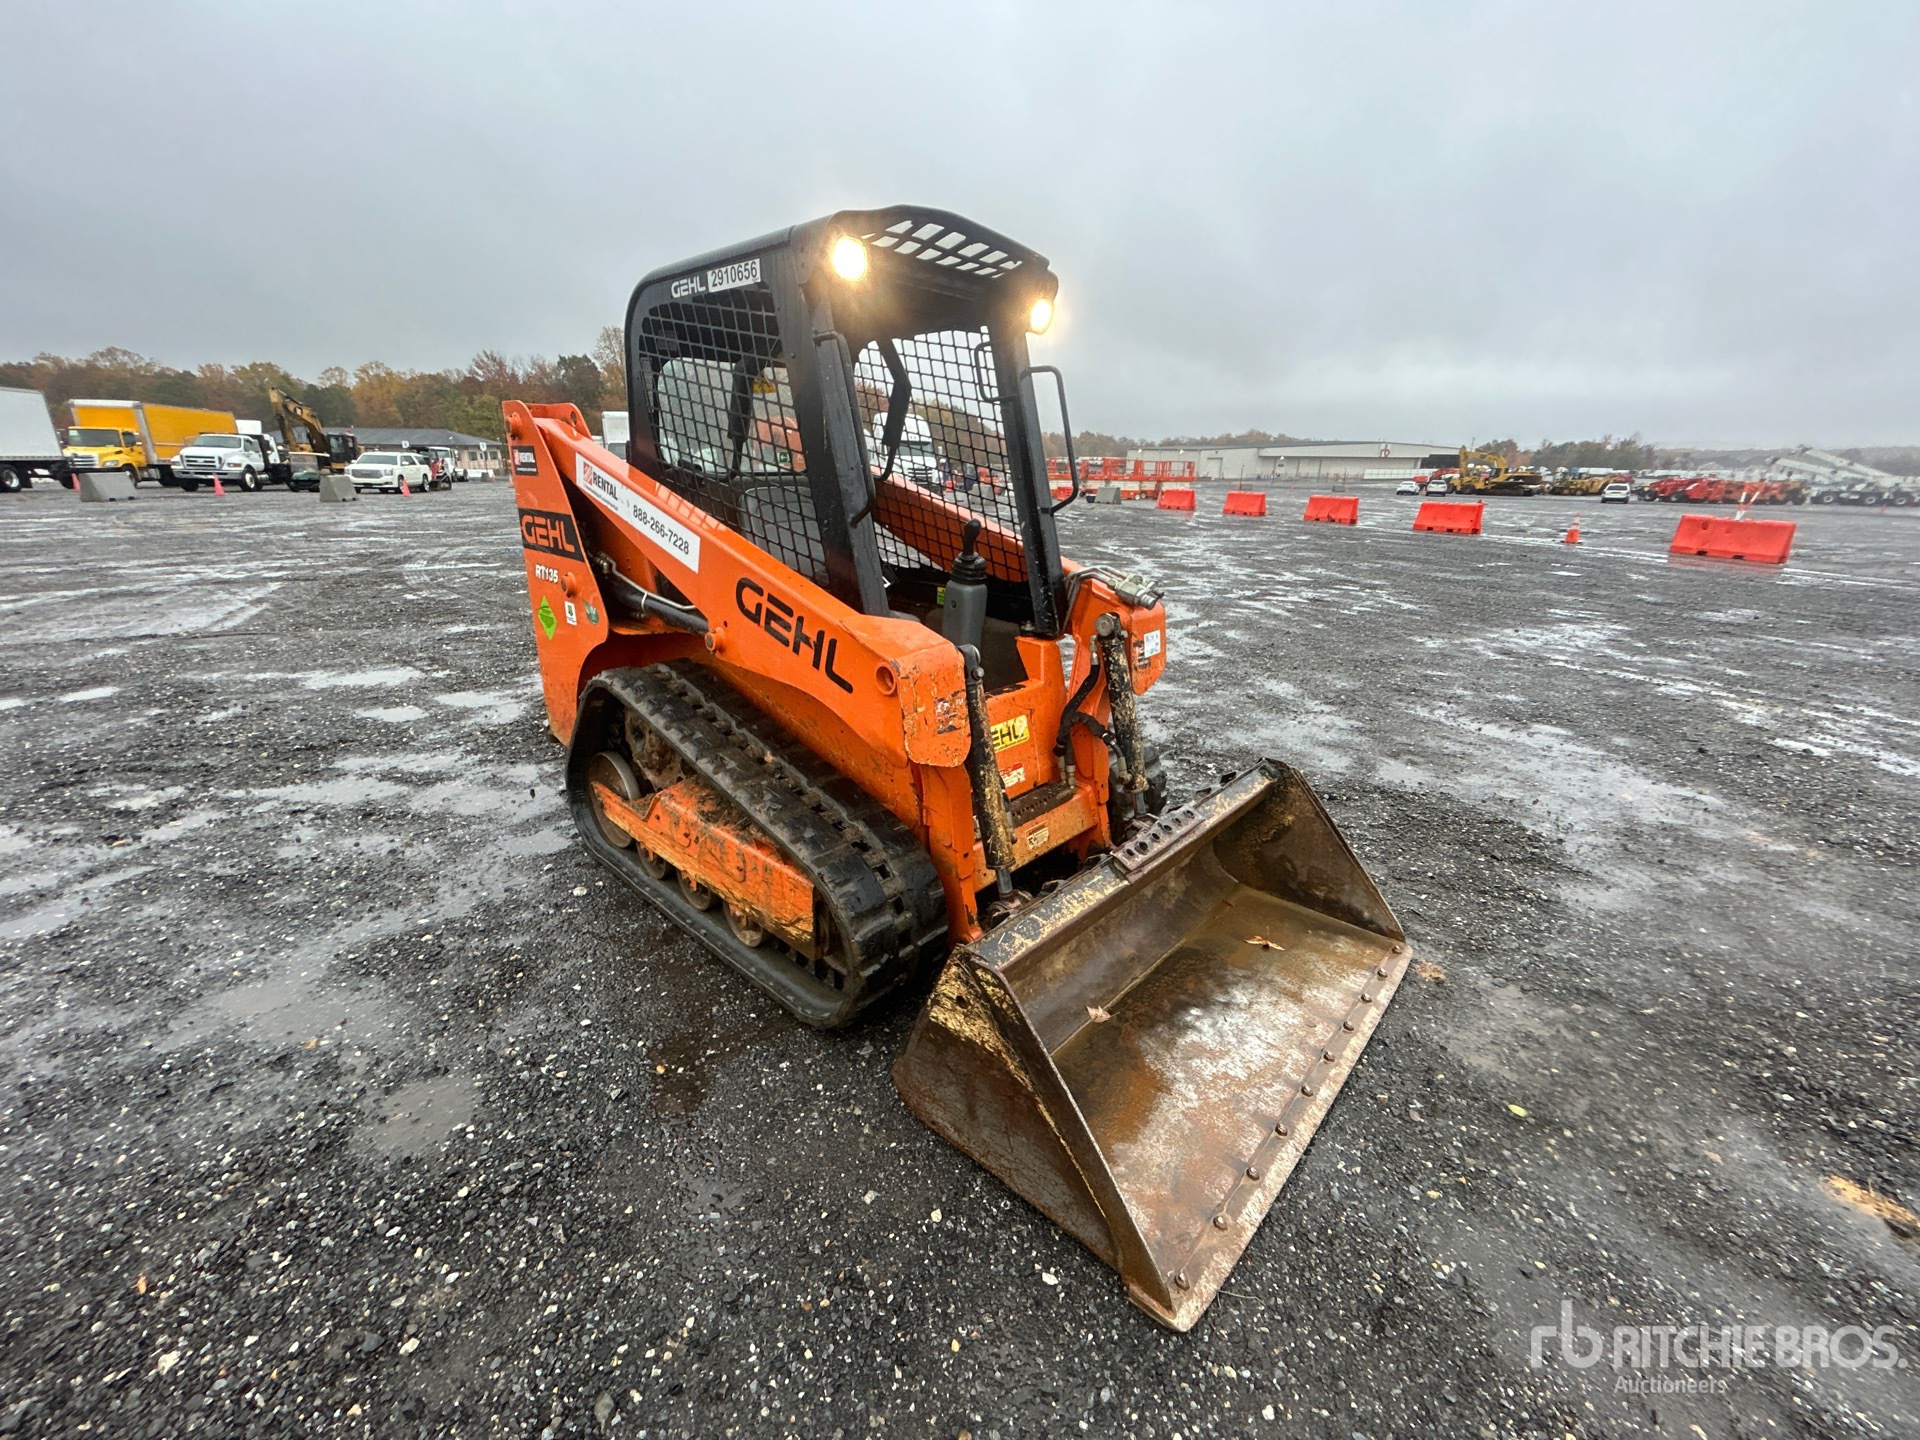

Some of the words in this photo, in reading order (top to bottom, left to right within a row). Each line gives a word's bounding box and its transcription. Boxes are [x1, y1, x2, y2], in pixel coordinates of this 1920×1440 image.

[671, 276, 706, 298] GEHL
[711, 261, 758, 287] 2910656
[593, 472, 618, 500] RENTAL
[521, 514, 575, 553] GEHL
[633, 505, 690, 555] 888-266-7228
[535, 564, 559, 584] RT135
[735, 576, 854, 694] GEHL
[990, 724, 1025, 747] EHL
